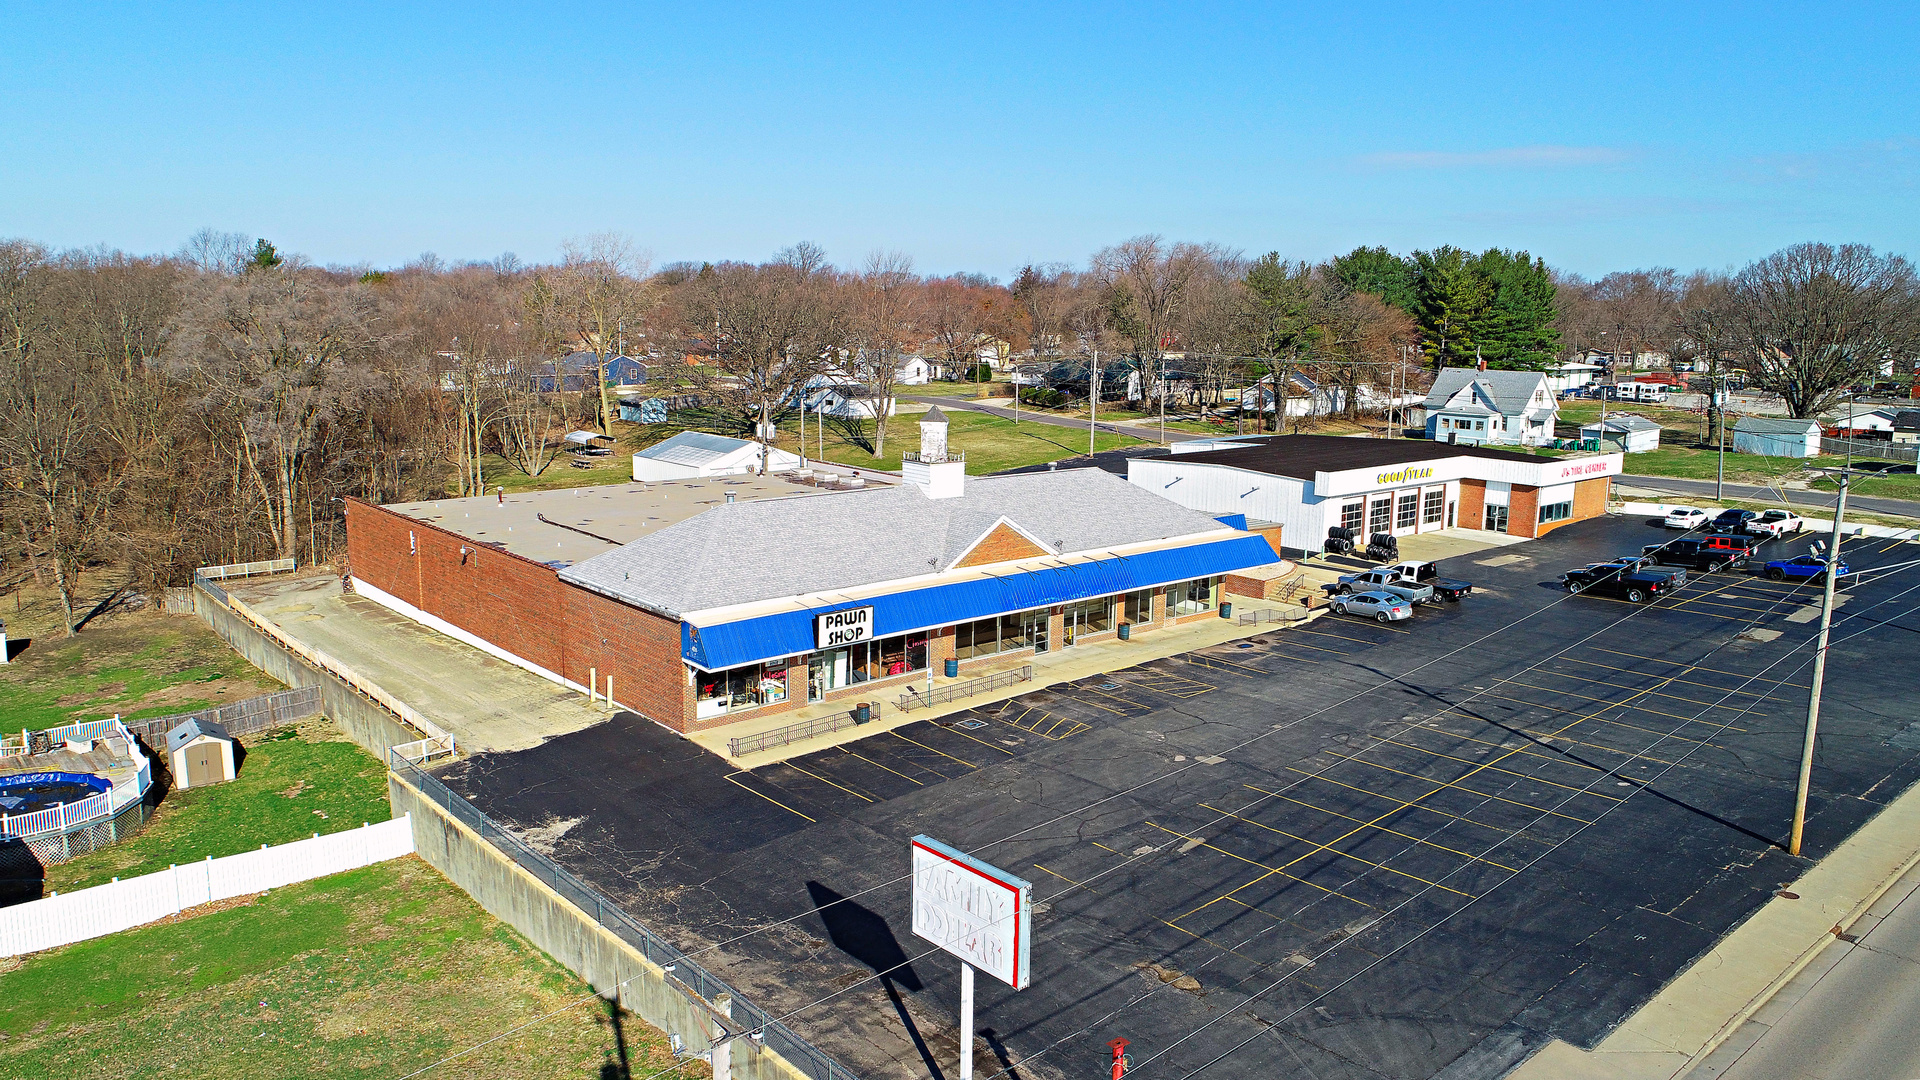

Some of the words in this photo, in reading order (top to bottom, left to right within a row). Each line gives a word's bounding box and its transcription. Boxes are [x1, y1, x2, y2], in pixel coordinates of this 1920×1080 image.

[1377, 466, 1433, 484] GOODYEAR
[826, 609, 867, 629] PAWN
[828, 626, 864, 646] SHOP
[917, 857, 1005, 928] FAMILY
